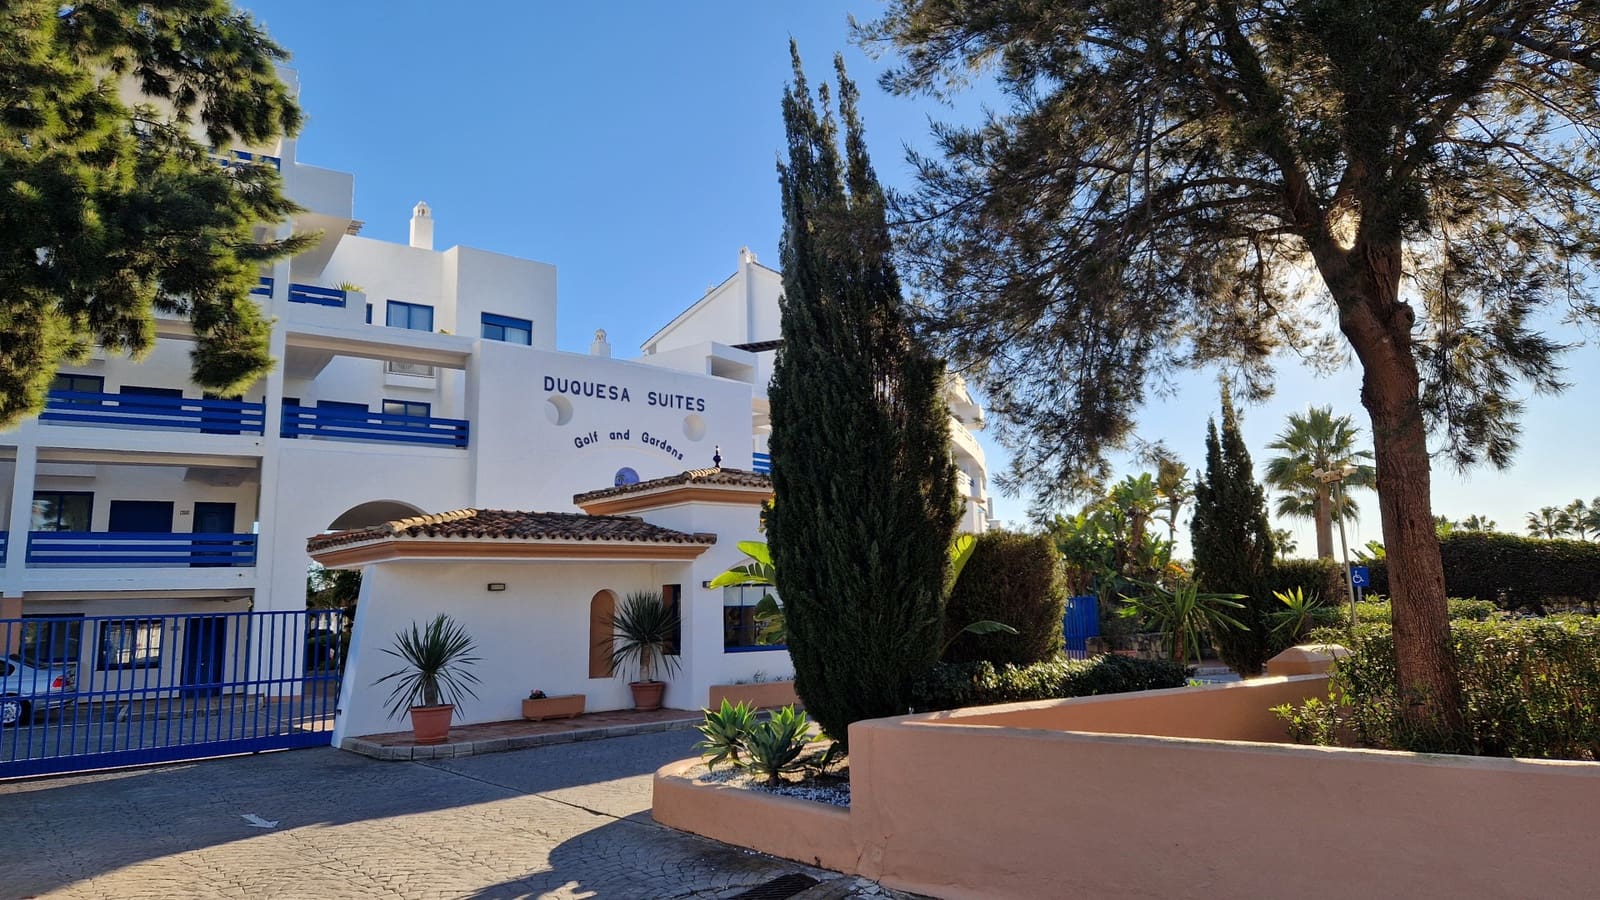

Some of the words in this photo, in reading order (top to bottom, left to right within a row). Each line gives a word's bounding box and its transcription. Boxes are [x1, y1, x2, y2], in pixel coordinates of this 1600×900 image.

[544, 376, 631, 402] DUQUESA
[647, 391, 705, 412] SUITES
[574, 430, 599, 449] Golf
[609, 429, 630, 441] and
[641, 431, 684, 461] Gardens
